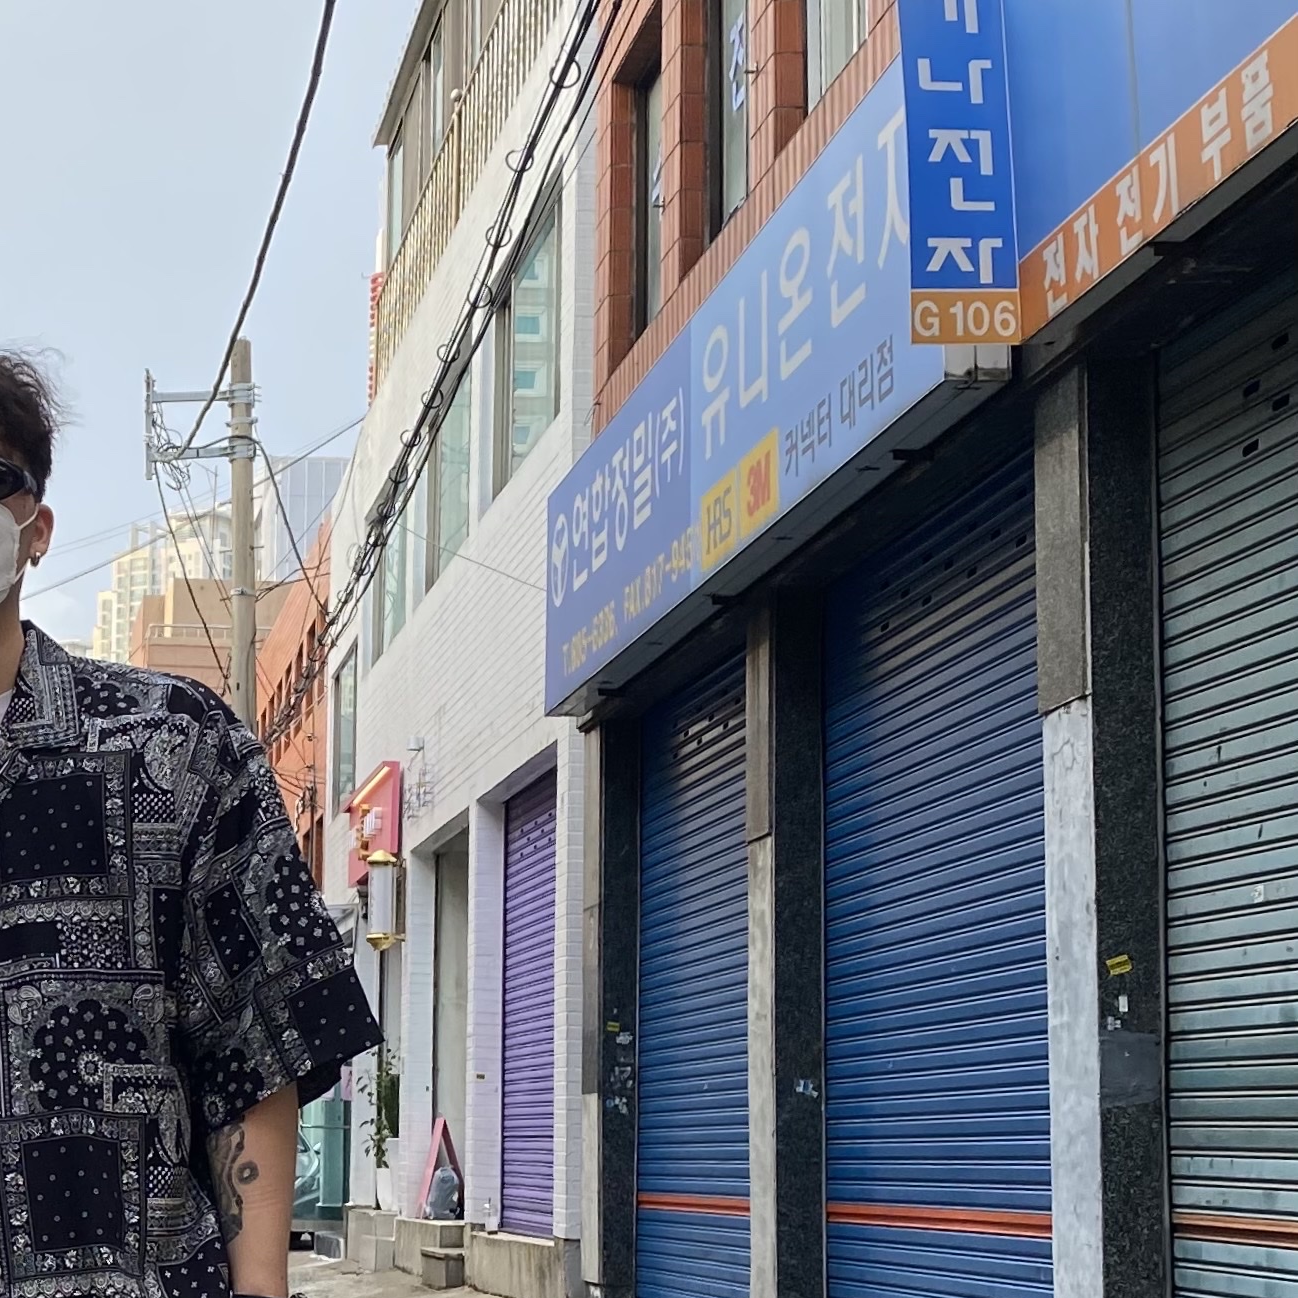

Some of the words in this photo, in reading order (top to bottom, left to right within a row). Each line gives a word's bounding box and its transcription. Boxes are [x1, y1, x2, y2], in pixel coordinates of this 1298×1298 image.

[1043, 204, 1098, 318] 전자
[1116, 132, 1180, 257] 전기
[1200, 49, 1273, 181] 부품
[573, 387, 684, 592] 연합정밀(주)
[747, 449, 771, 518] 3M
[785, 392, 832, 477] 커넥터
[840, 334, 894, 430] 대리점
